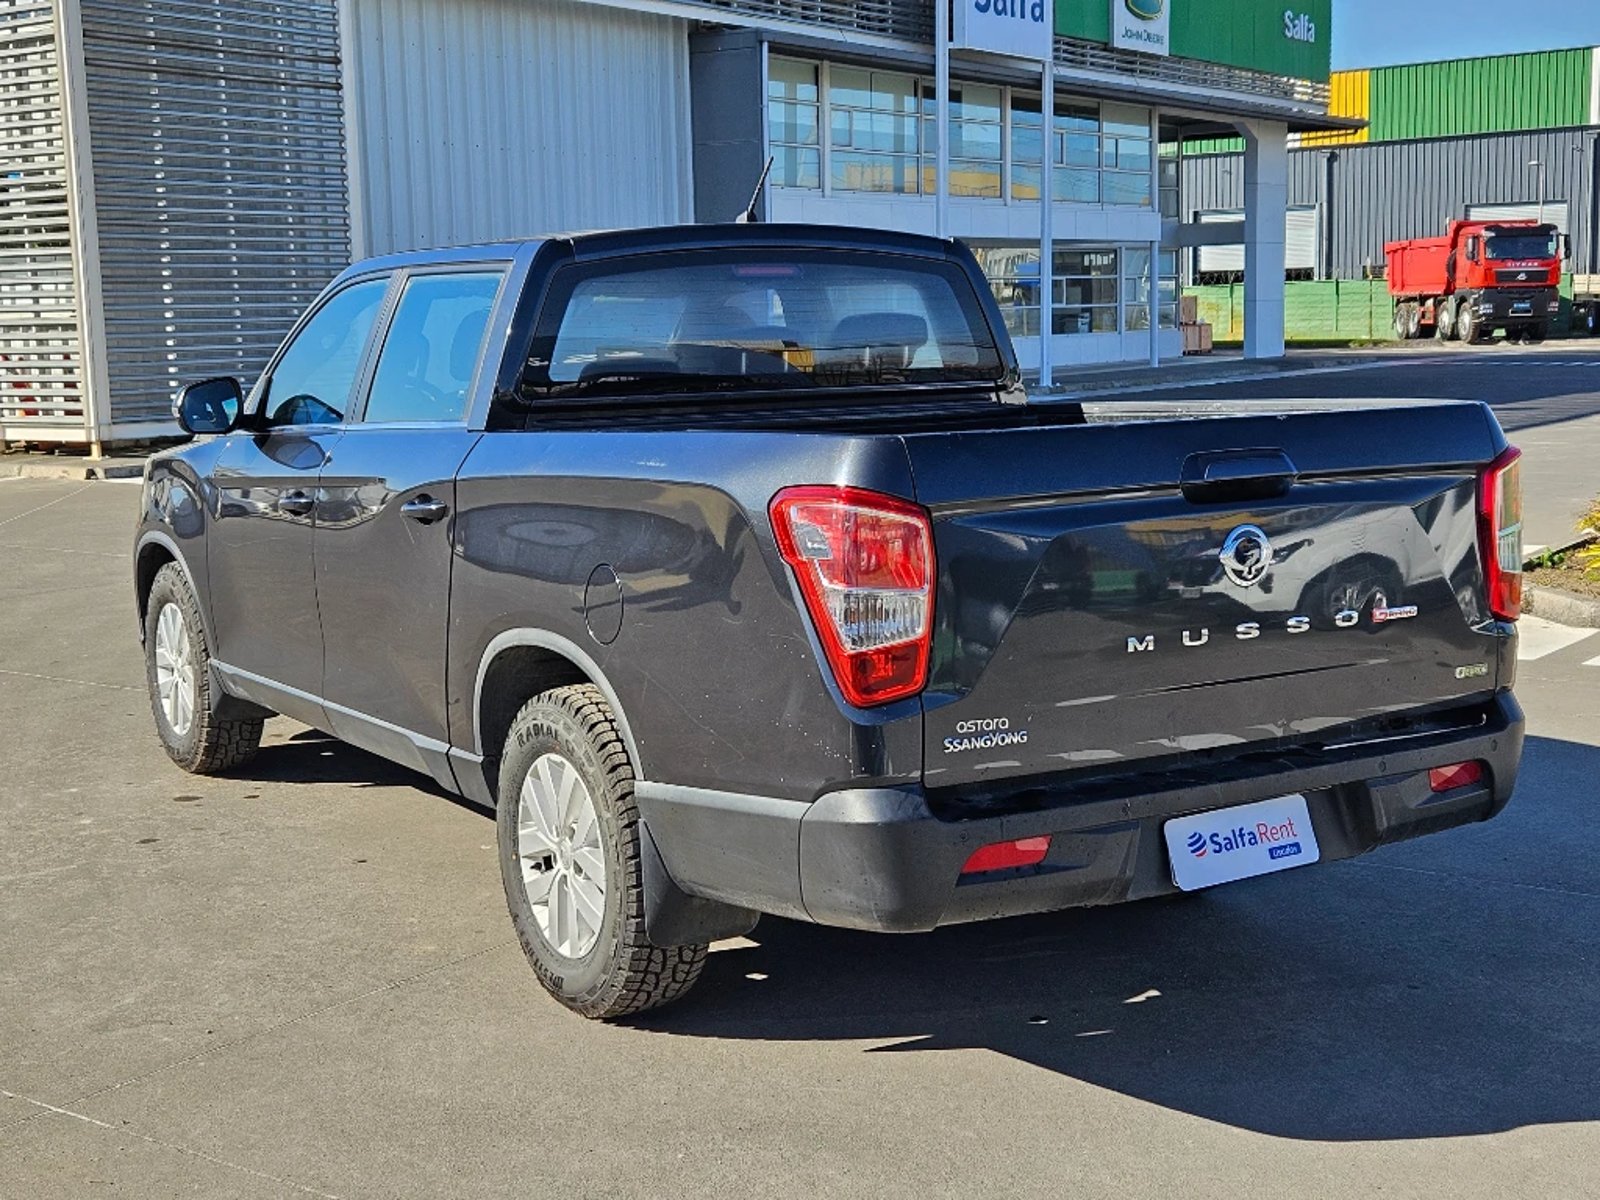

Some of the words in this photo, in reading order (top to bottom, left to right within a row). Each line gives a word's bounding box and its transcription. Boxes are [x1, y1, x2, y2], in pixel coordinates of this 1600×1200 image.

[1121, 26, 1143, 41] JOHN
[1284, 10, 1315, 43] Salfa
[1126, 609, 1360, 654] MUSSO
[516, 722, 560, 748] RADIAL
[943, 730, 1028, 753] SSANGYONG
[1209, 817, 1298, 854] SalfaRent
